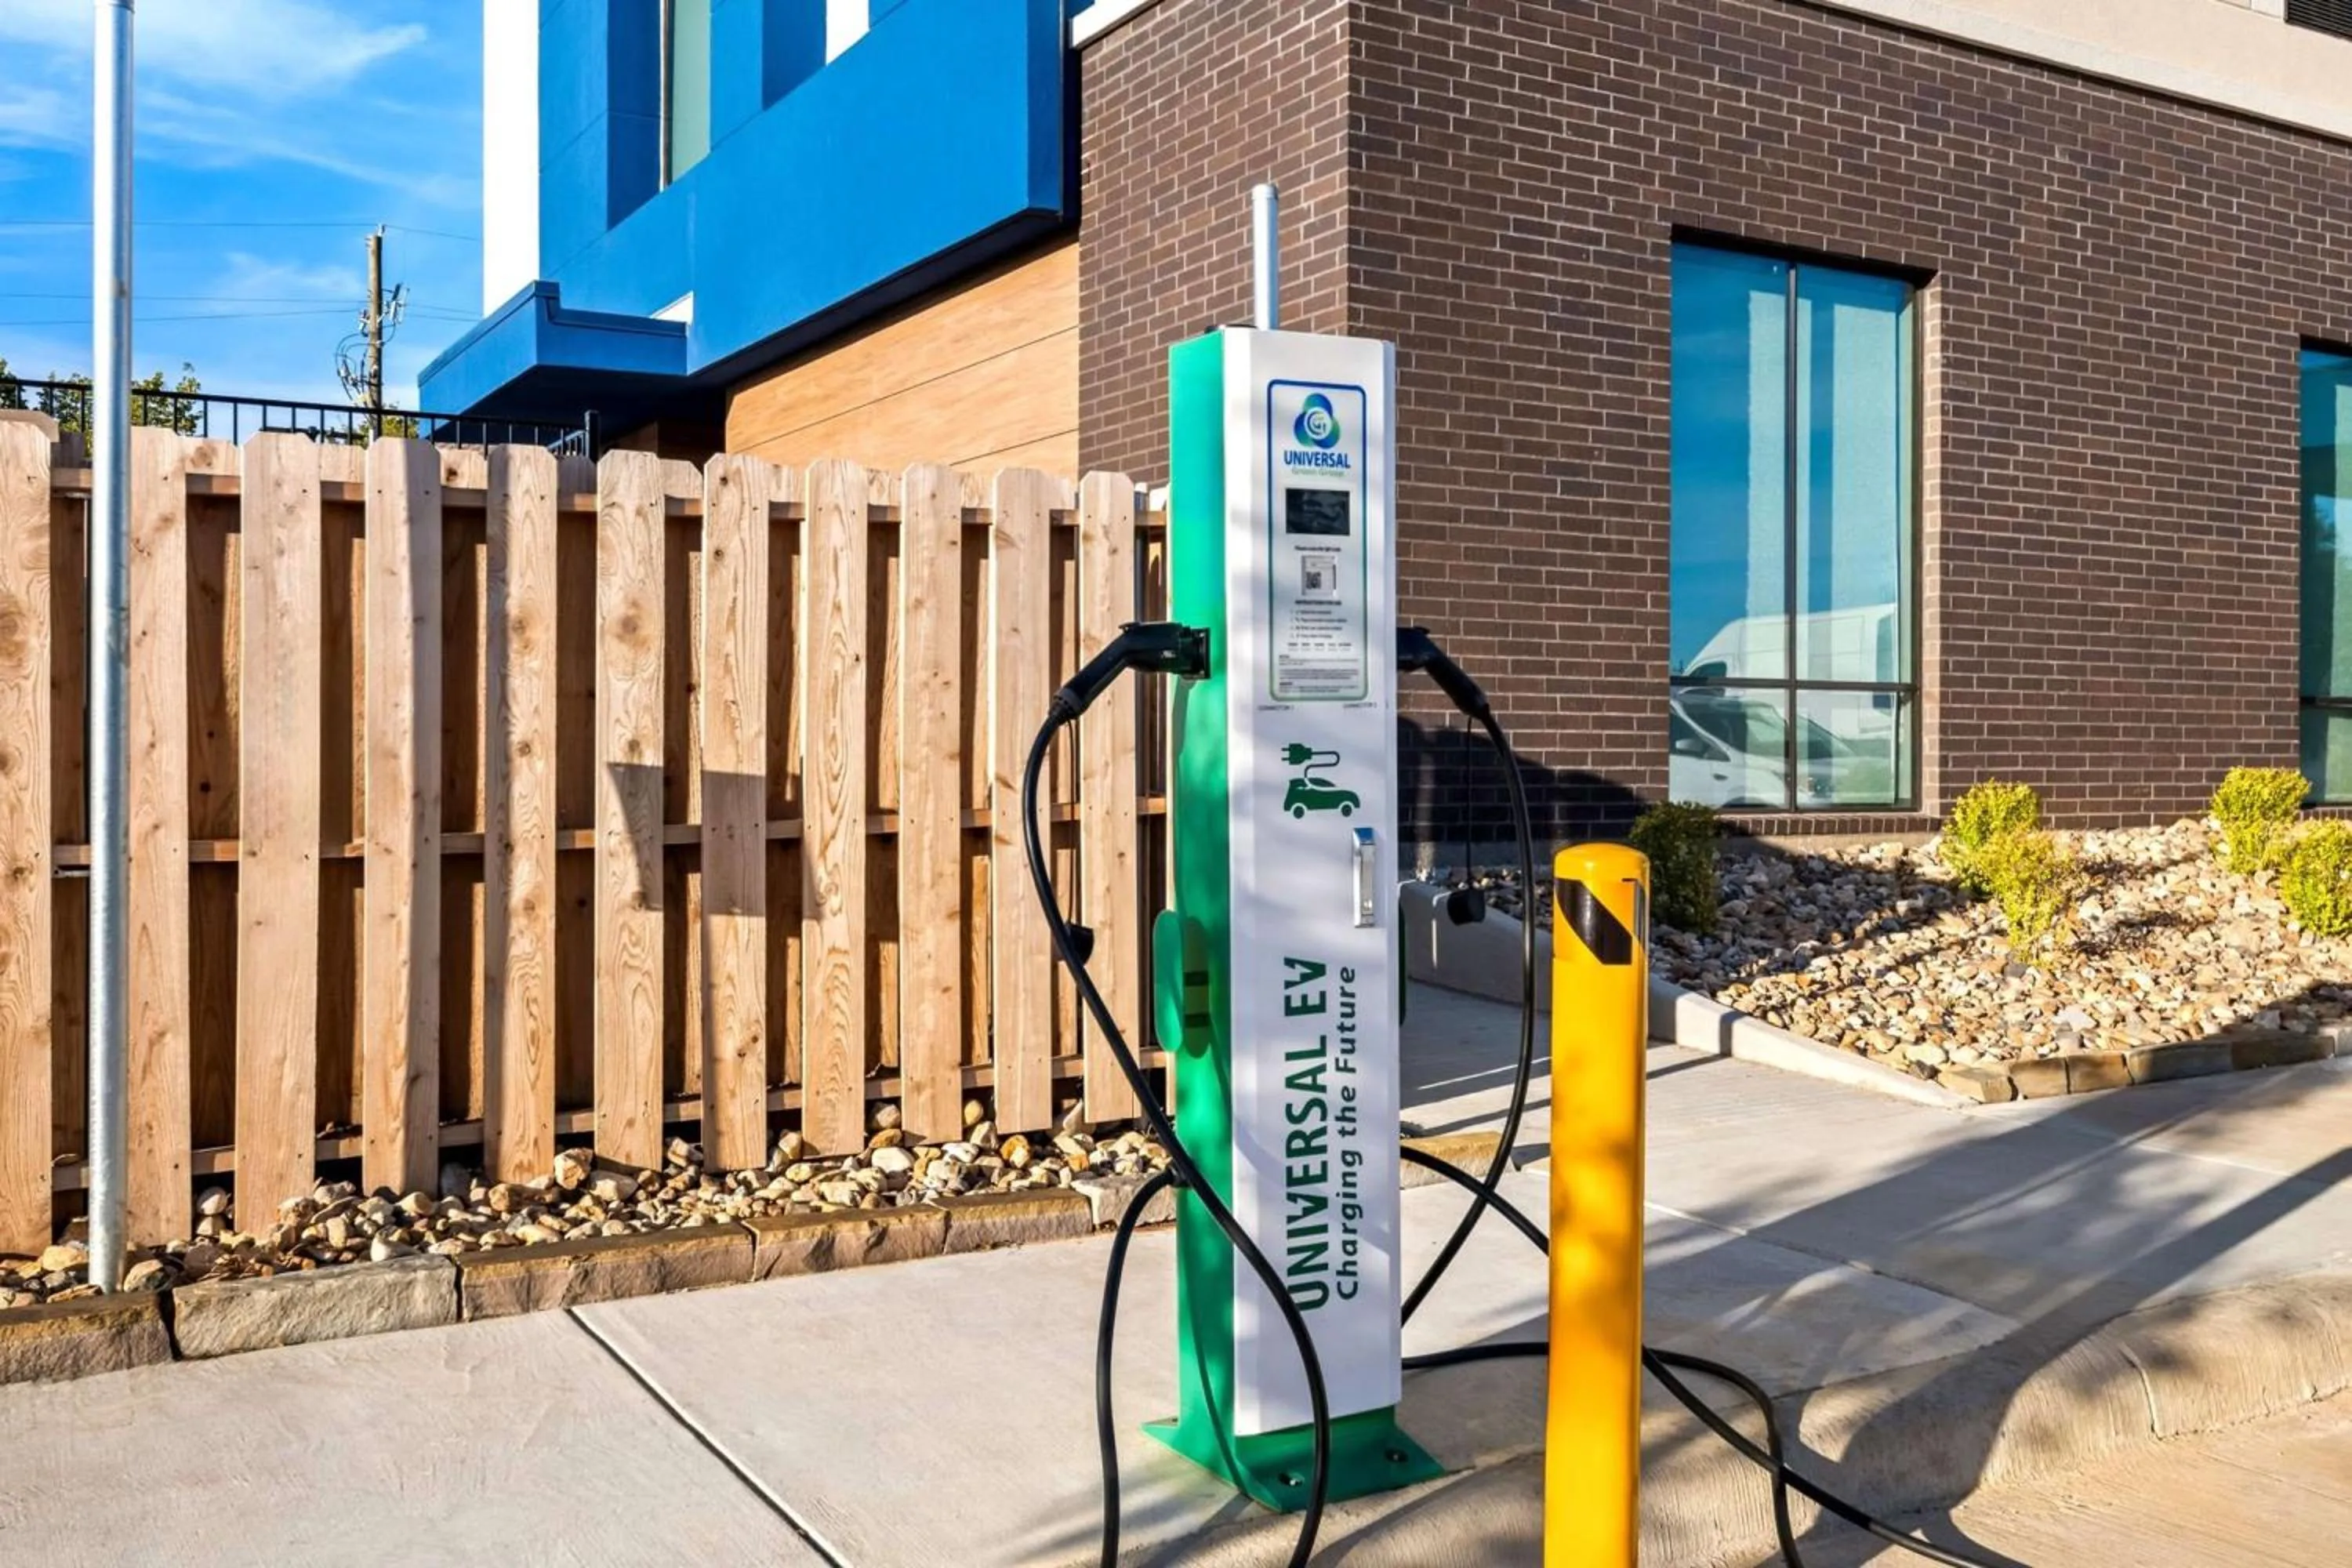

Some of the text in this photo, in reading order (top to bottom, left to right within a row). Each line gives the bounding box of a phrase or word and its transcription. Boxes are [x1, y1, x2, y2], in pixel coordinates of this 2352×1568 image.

[1284, 450, 1351, 468] UNIVERSAL
[1283, 956, 1330, 1311] UNIVERSAL EV
[1334, 966, 1363, 1300] Charging the Future
